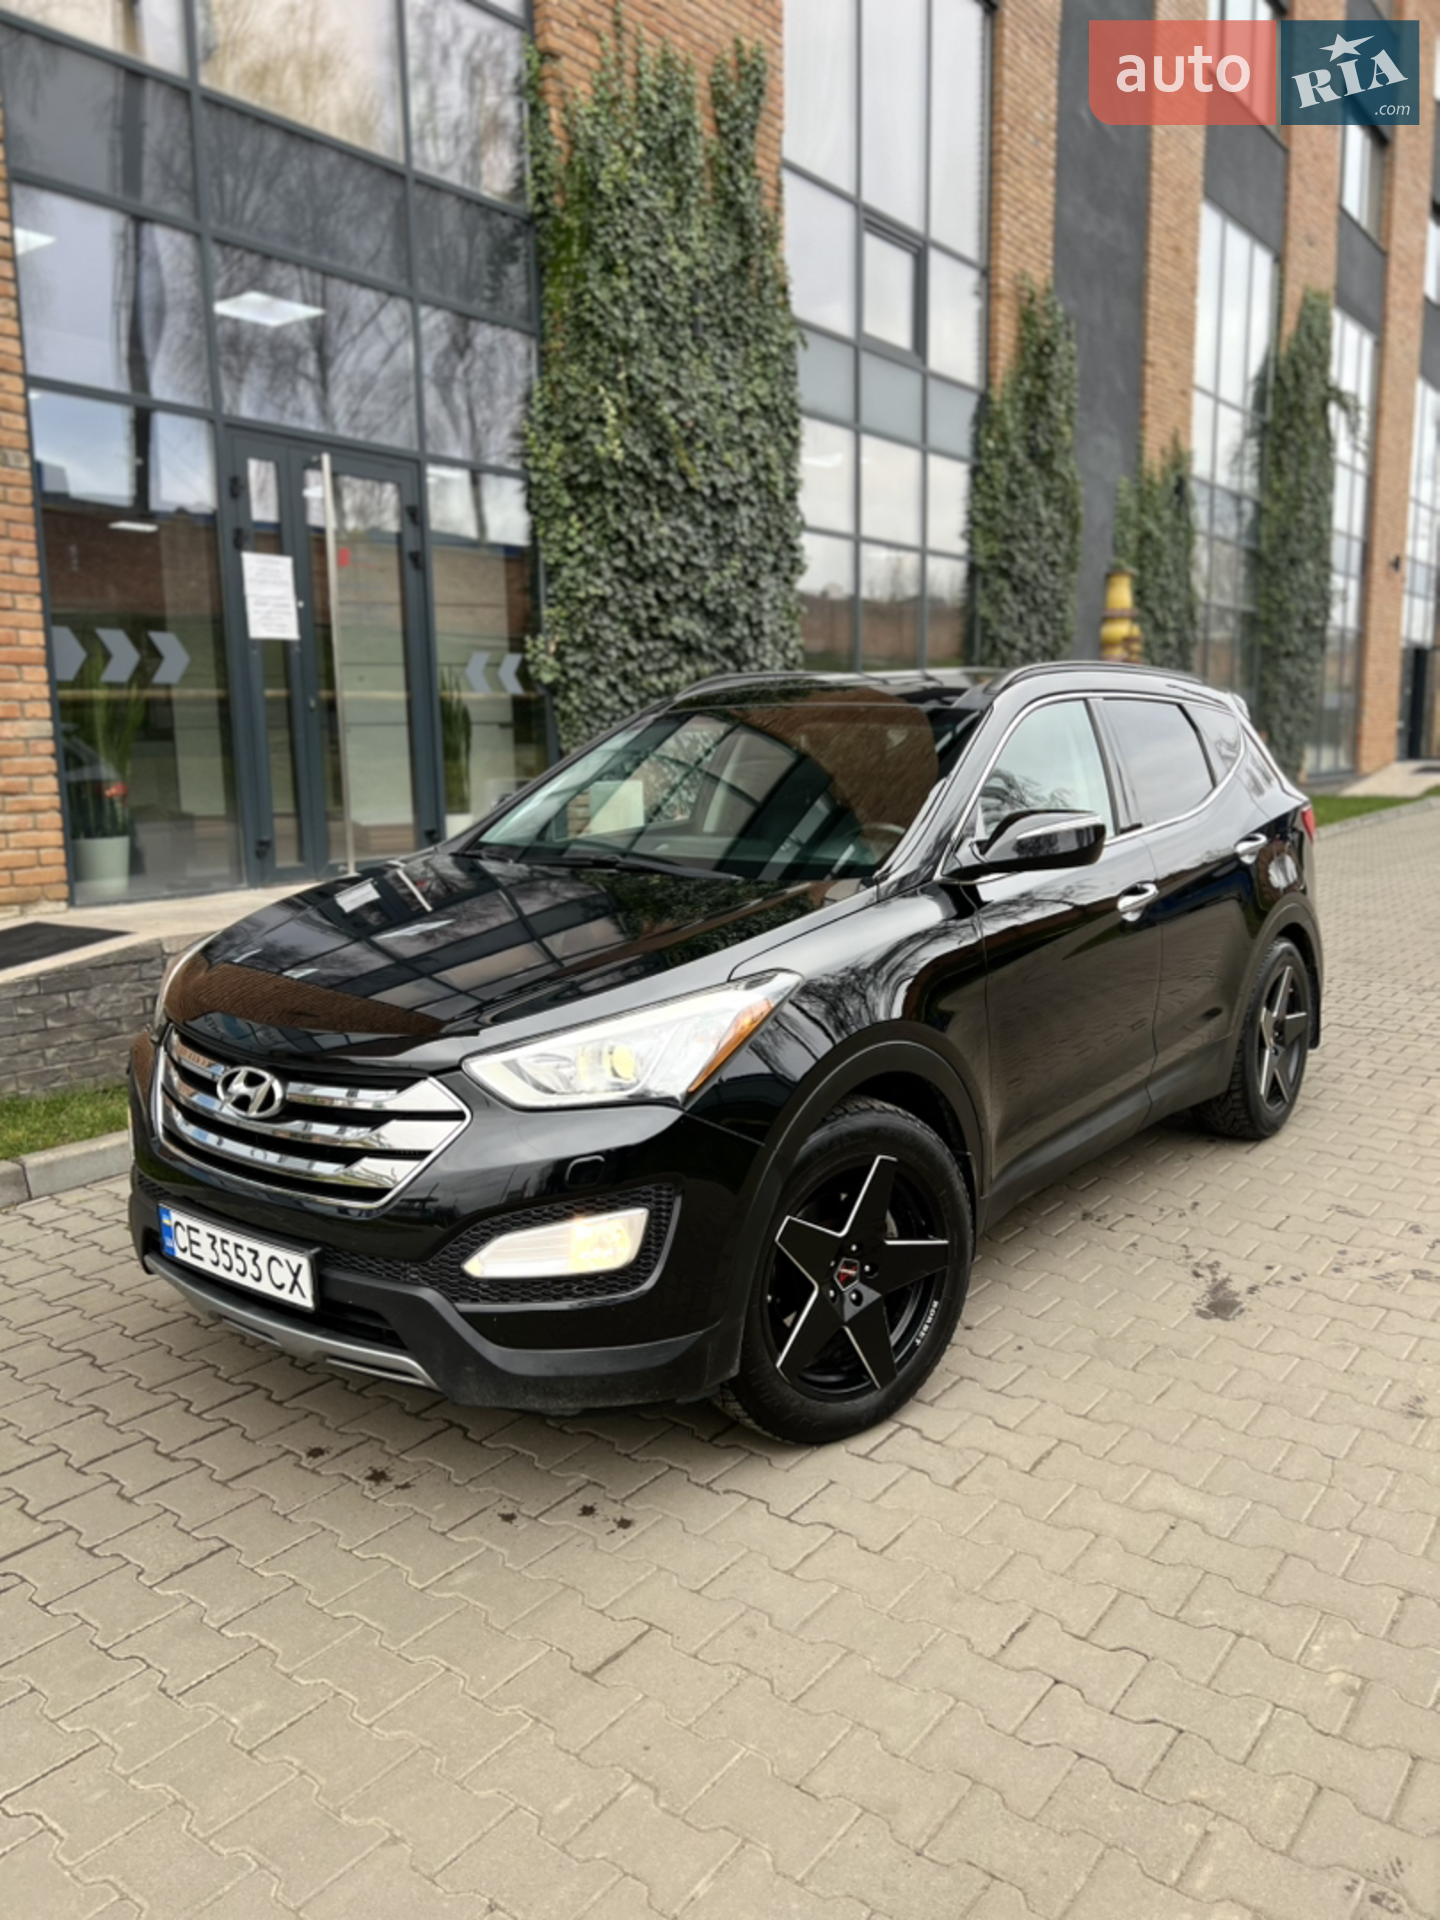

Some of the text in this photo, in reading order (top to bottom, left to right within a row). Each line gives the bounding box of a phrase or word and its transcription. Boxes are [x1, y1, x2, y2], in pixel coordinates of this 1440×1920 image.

[173, 1220, 307, 1299] CE 3553 CX
